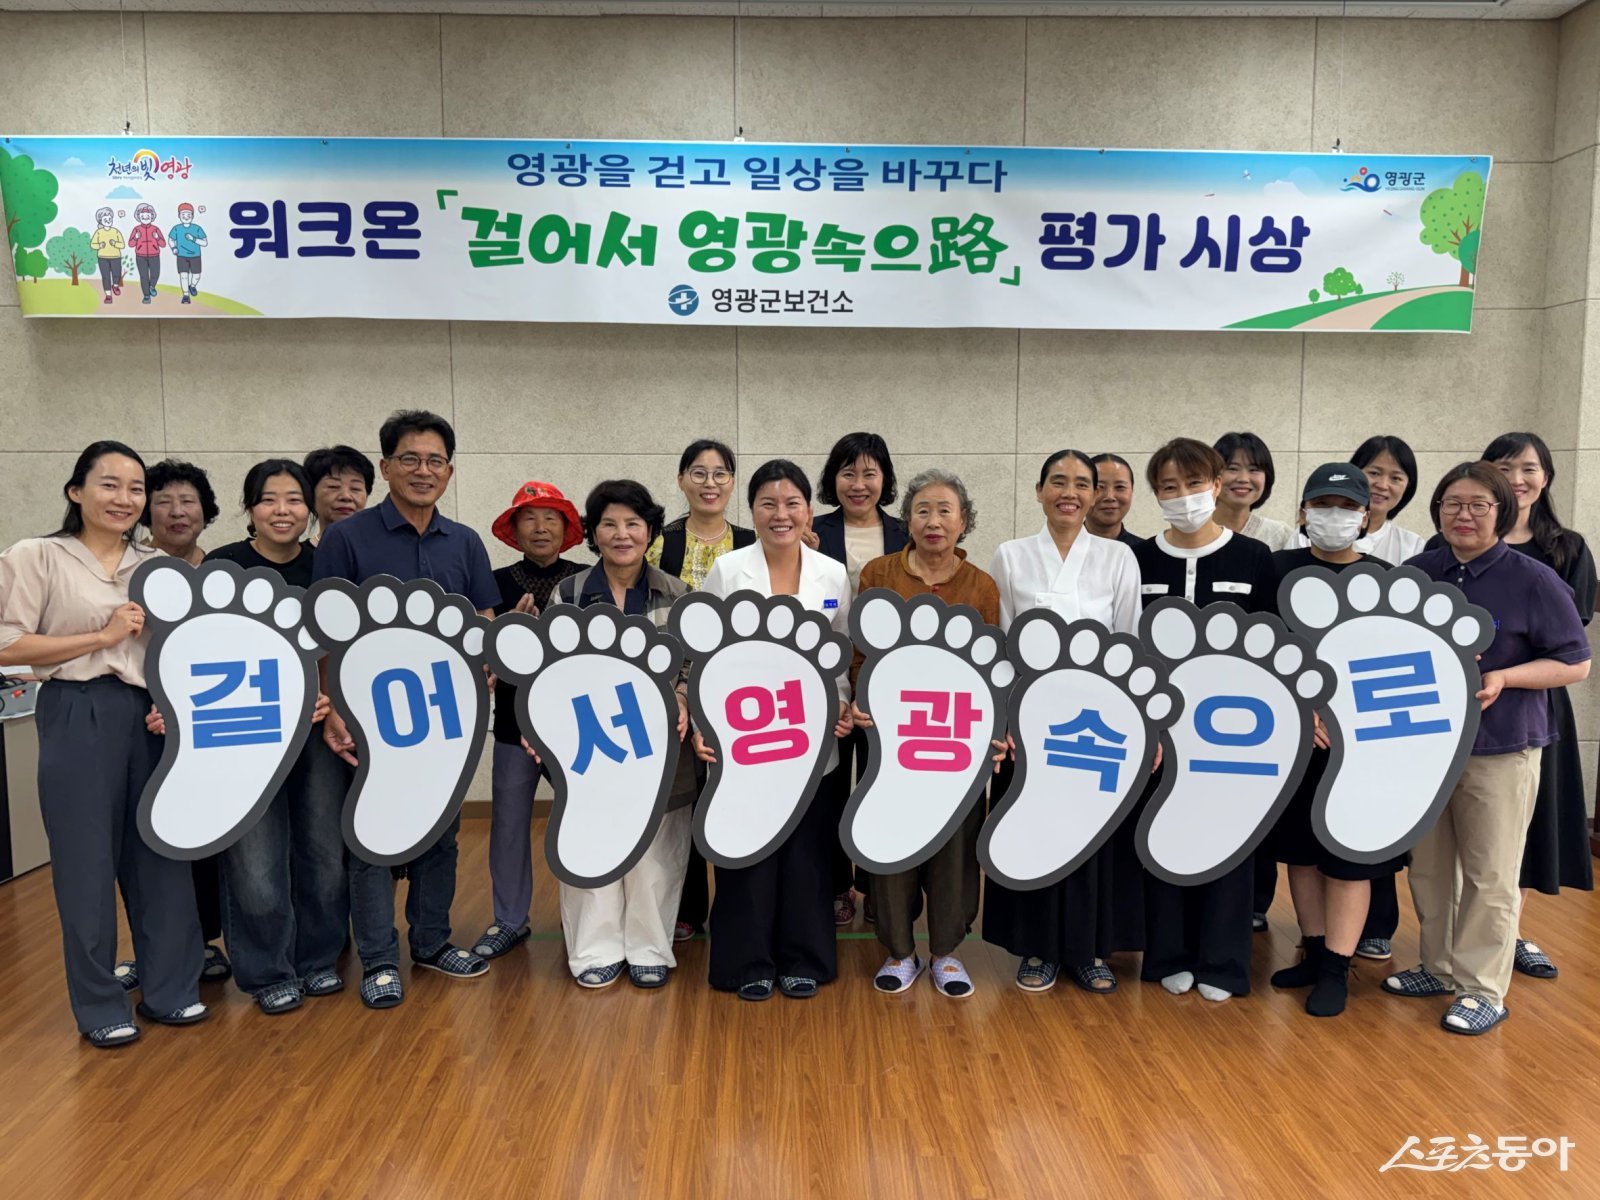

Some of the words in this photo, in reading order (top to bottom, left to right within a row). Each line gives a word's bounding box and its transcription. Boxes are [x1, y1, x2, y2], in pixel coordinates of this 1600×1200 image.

[507, 152, 635, 187] 영광을
[647, 155, 731, 188] 걷고
[743, 157, 869, 191] 일상을
[882, 159, 1008, 192] 바꾸다
[1384, 171, 1426, 187] 영광군
[229, 200, 422, 259] 워크온
[1038, 211, 1166, 271] 평가
[1179, 214, 1311, 273] 시상
[711, 288, 854, 314] 영광군보건소
[190, 658, 282, 749] 걸
[371, 660, 463, 748] 어
[570, 682, 653, 775] 서
[724, 679, 810, 766] 영
[897, 690, 983, 772] 광
[1189, 695, 1279, 776] 으
[1348, 650, 1452, 741] 로
[1042, 708, 1127, 793] 속
